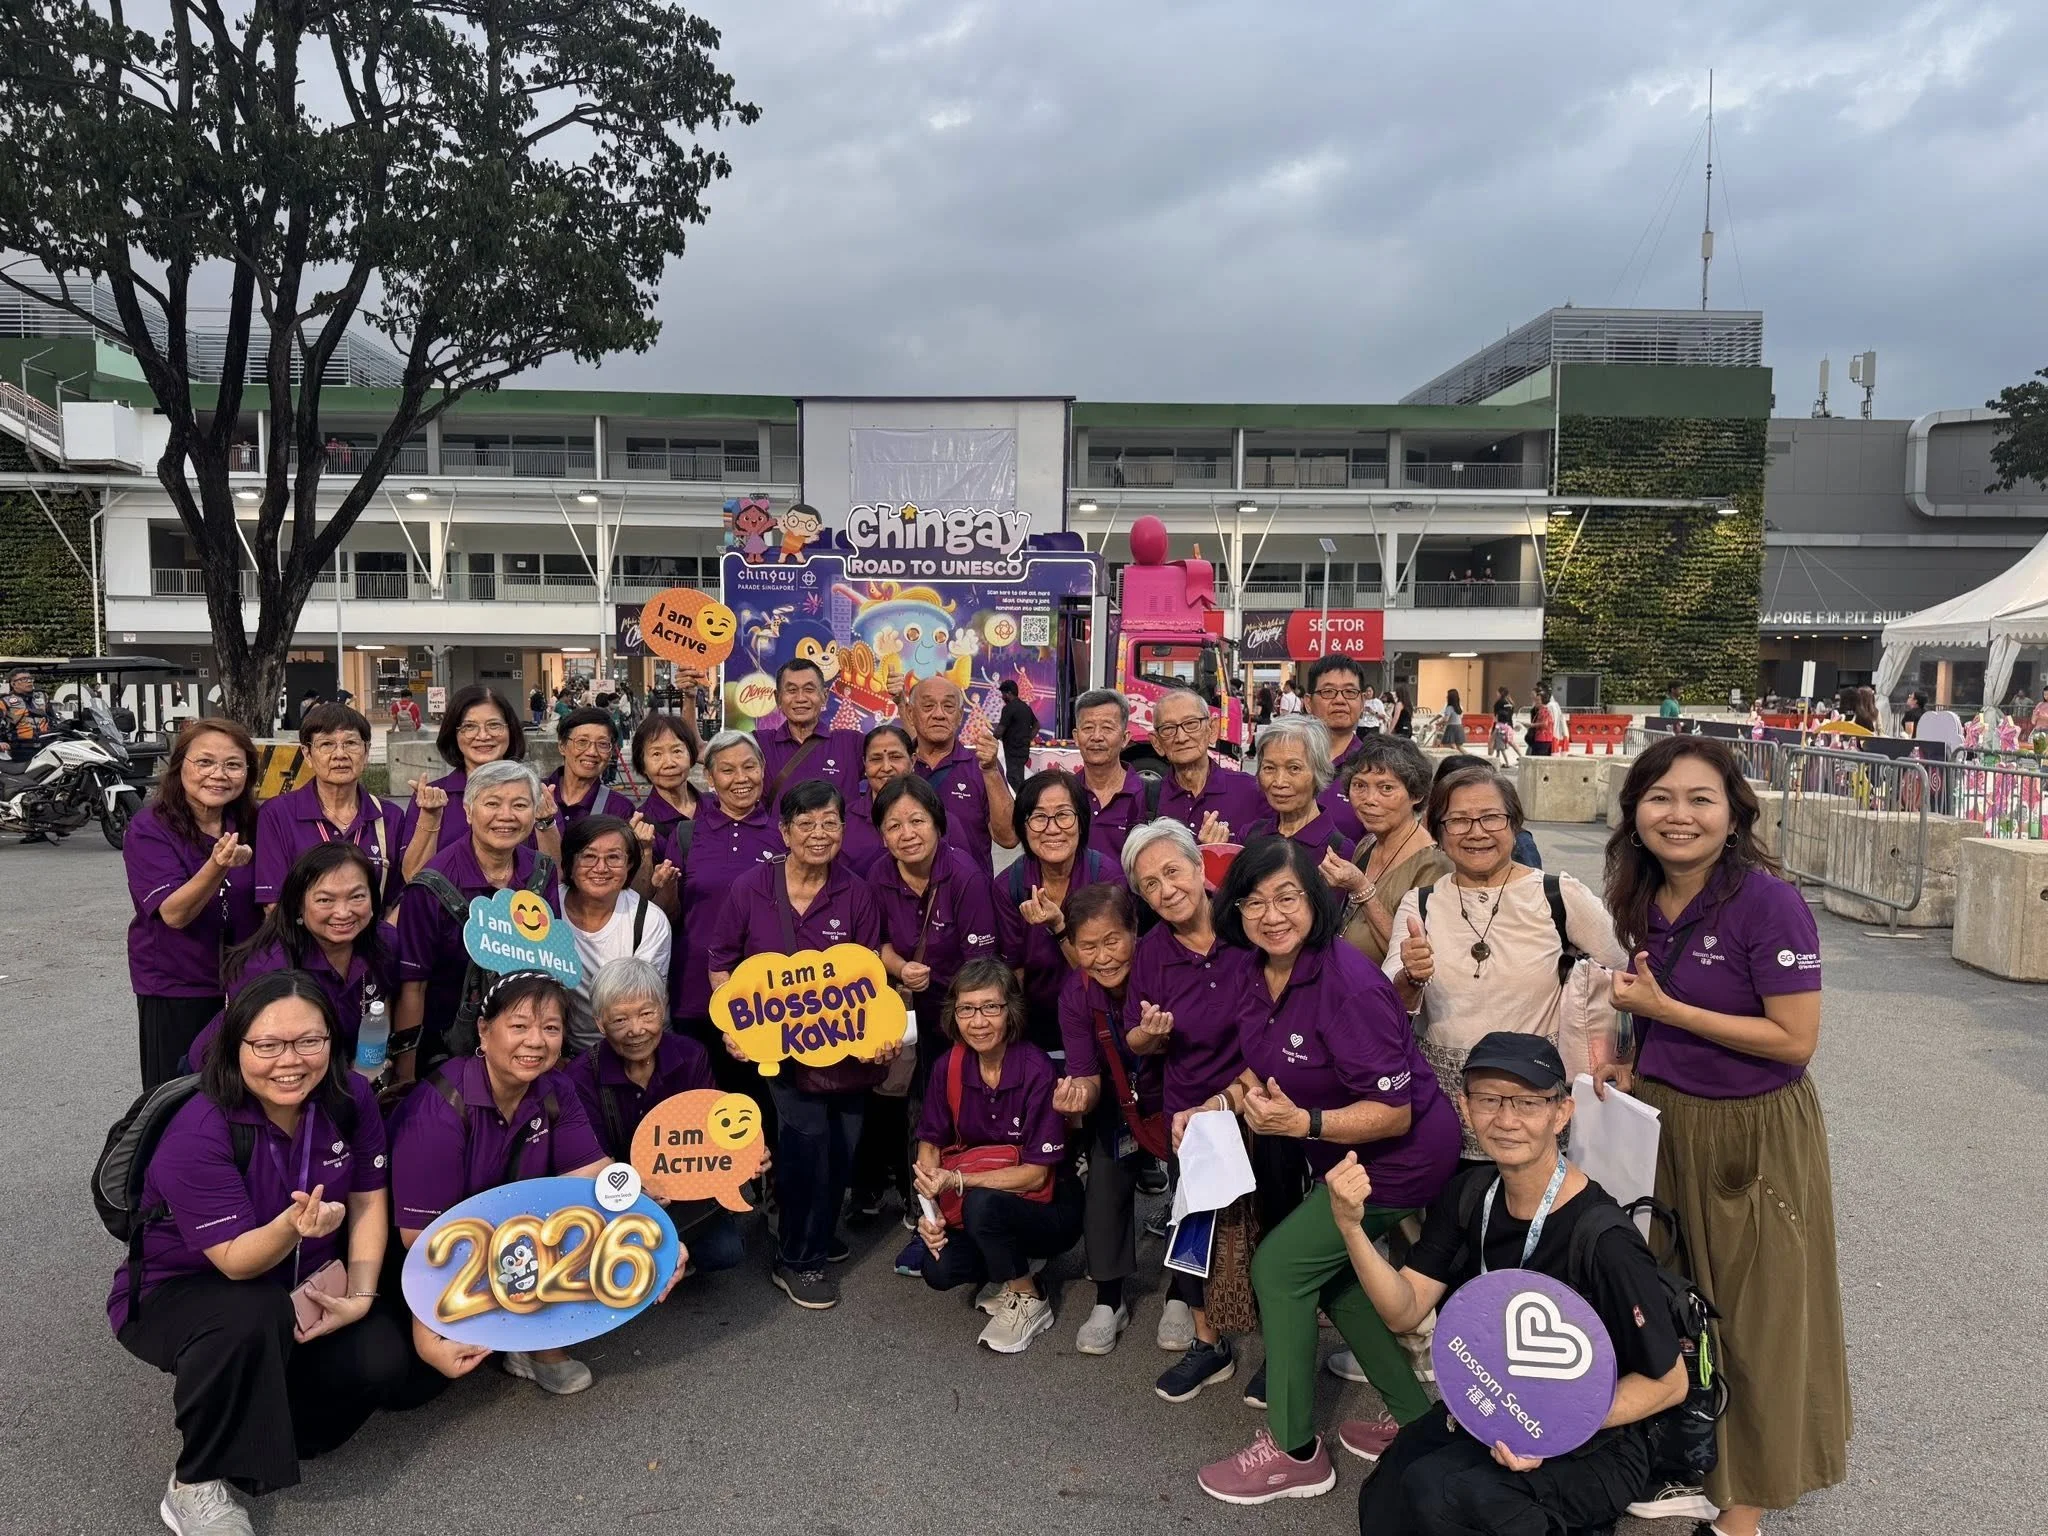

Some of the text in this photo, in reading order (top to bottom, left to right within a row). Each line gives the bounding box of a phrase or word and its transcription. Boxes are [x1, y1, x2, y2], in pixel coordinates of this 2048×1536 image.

[737, 567, 795, 584] chingay
[851, 560, 1022, 576] ROAD TO UNESCO
[658, 603, 693, 629] I am
[1308, 619, 1364, 632] SECTOR
[1845, 611, 1867, 624] PIT
[1331, 639, 1342, 651] &
[1344, 639, 1364, 651] A8
[200, 669, 208, 677] 14
[513, 670, 522, 678] 12
[478, 910, 512, 935] I am
[480, 933, 577, 975] Ageing Well
[1796, 953, 1817, 961] Cares
[766, 962, 836, 990] I am a
[727, 976, 877, 1031] Blossom
[781, 1007, 866, 1055] Kaki!
[653, 1125, 704, 1146] I am
[425, 1205, 663, 1324] 2026
[1448, 1335, 1544, 1439] Blossom Seeds
[1464, 1384, 1497, 1417] 福善
